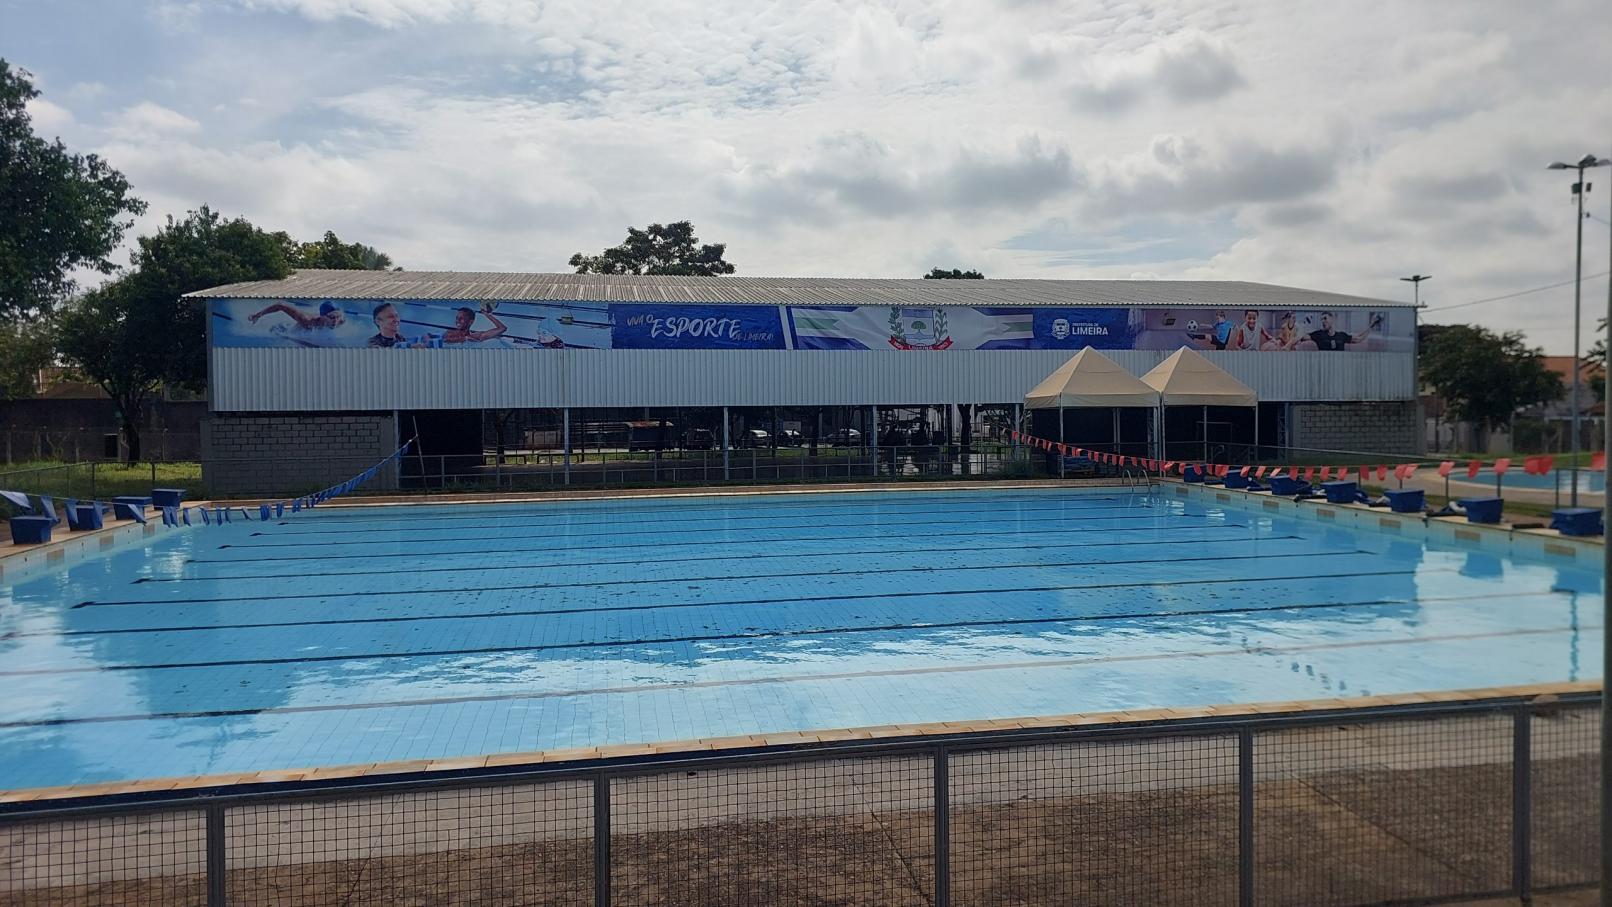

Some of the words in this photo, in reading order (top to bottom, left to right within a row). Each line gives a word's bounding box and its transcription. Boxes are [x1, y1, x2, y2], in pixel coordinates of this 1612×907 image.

[646, 314, 654, 323] O
[651, 317, 741, 338] ESPORTE
[1072, 327, 1108, 335] LIMEIRA
